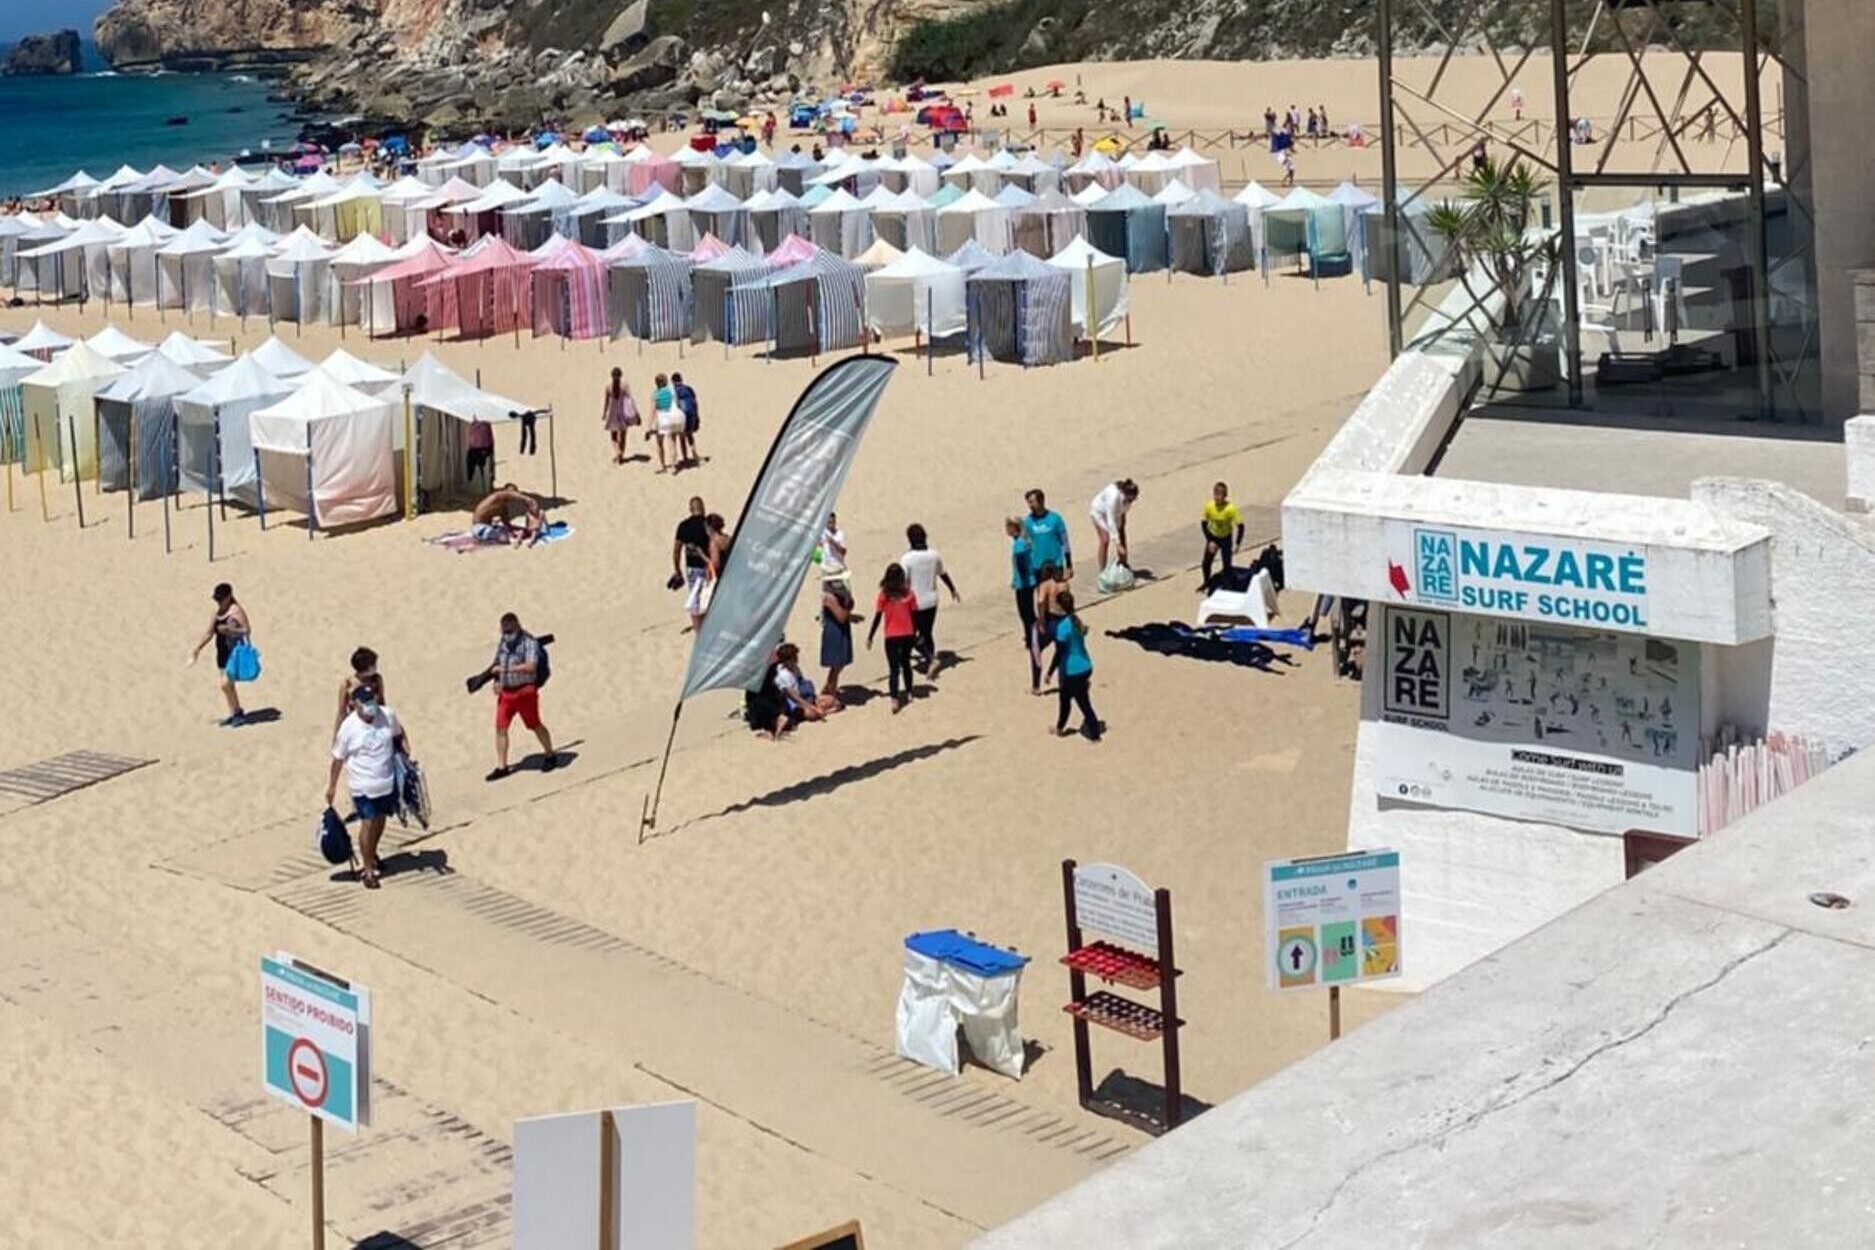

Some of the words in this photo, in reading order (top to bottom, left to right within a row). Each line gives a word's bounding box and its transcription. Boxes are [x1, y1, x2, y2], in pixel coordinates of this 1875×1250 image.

[1421, 536, 1450, 556] NA
[1422, 554, 1451, 575] ZA
[1461, 585, 1529, 612] SURF
[1538, 593, 1648, 627] SCHOOL
[1394, 616, 1442, 649] NA
[1394, 646, 1441, 679] ZA
[1384, 714, 1407, 724] SURF
[1410, 717, 1449, 732] SCHOOL
[1277, 884, 1328, 900] ENTRADA
[265, 985, 305, 1013] SENTIDO
[306, 1003, 354, 1036] PROIBIDO
